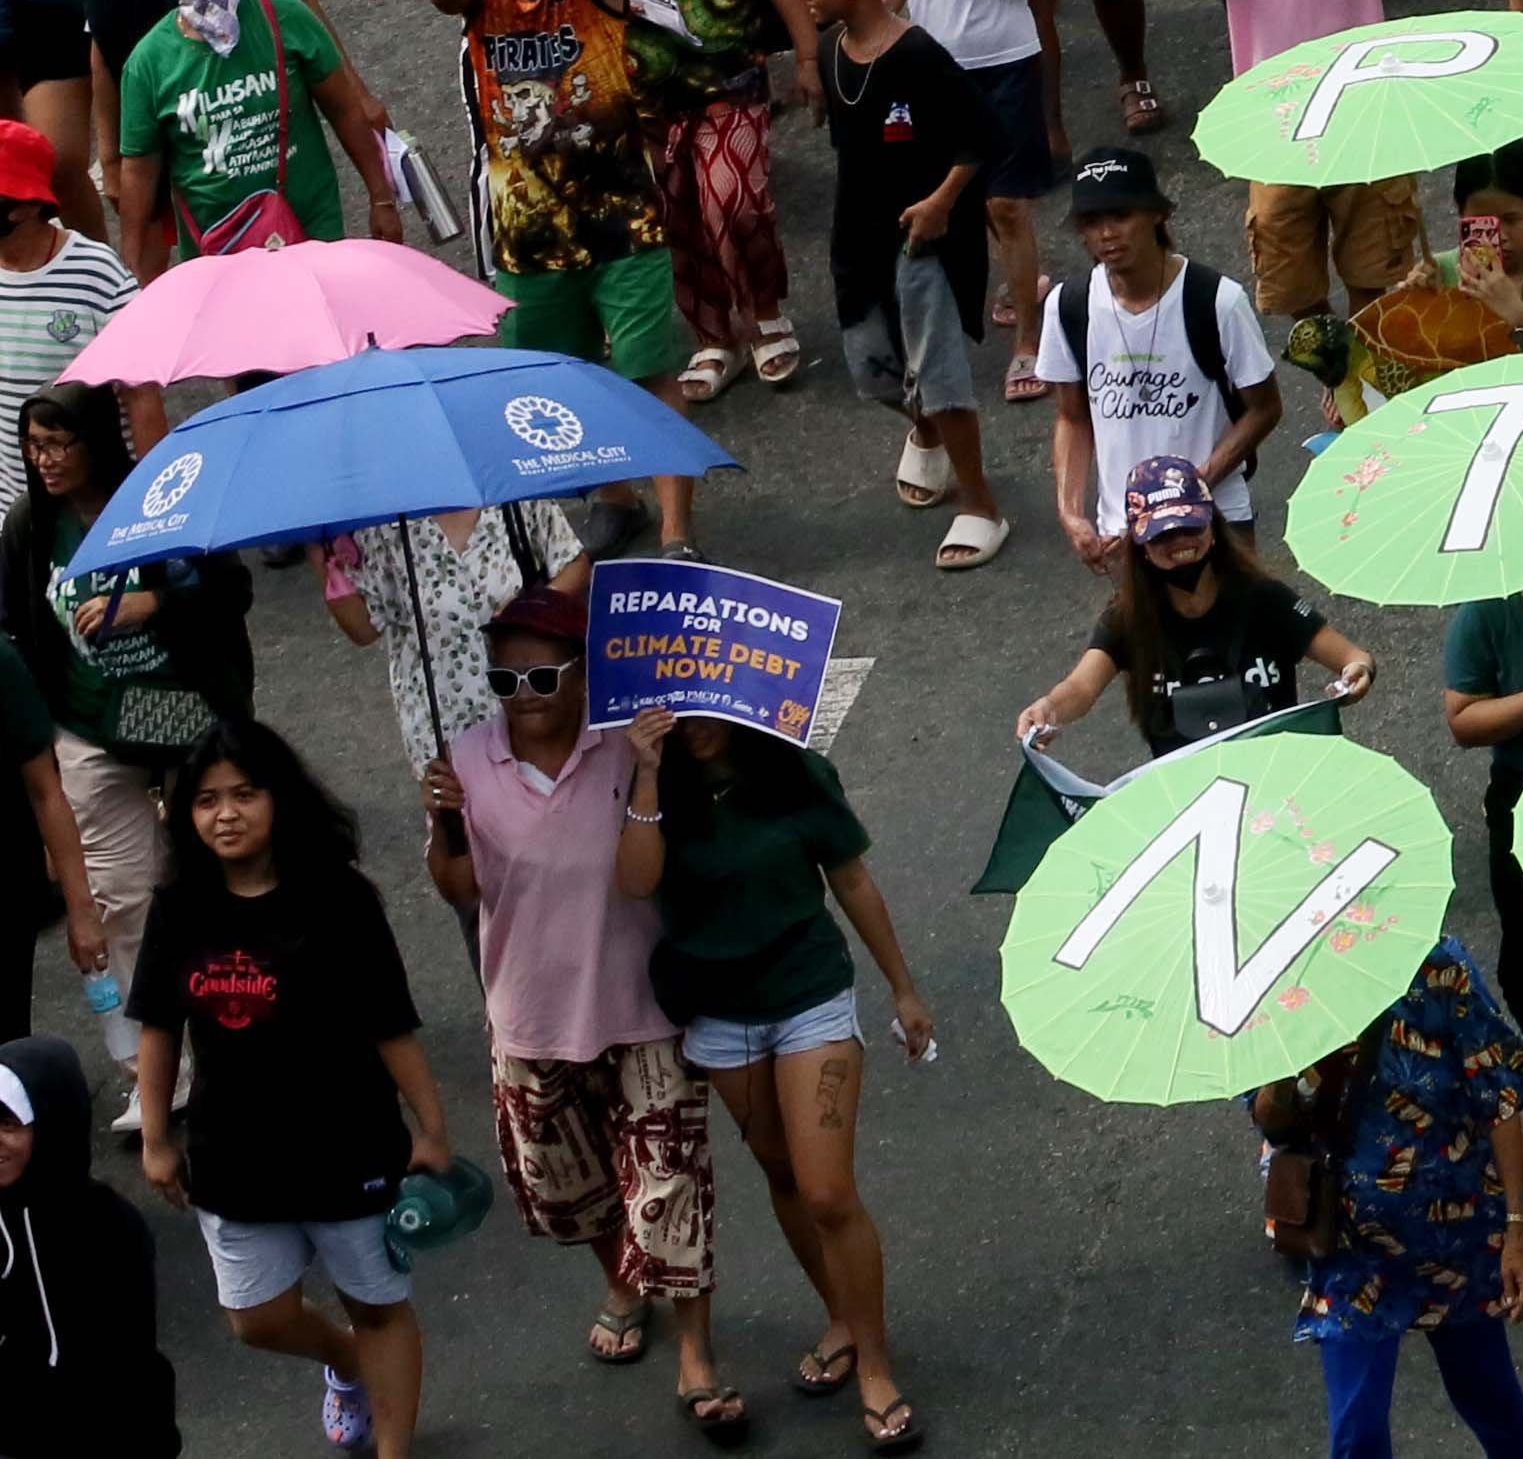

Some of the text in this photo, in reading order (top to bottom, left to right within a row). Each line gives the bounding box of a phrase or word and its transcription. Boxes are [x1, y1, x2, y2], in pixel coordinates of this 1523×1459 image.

[485, 24, 582, 71] PIRATES
[1089, 363, 1186, 403] Courage
[1102, 389, 1188, 419] Climate
[512, 446, 626, 471] THE MEDICAL CITY
[1148, 487, 1181, 505] PUMA
[610, 591, 809, 641] REPARATIONS
[682, 615, 722, 633] FOR
[606, 635, 801, 680] CLIMATE DEBT
[656, 658, 734, 683] NOW!
